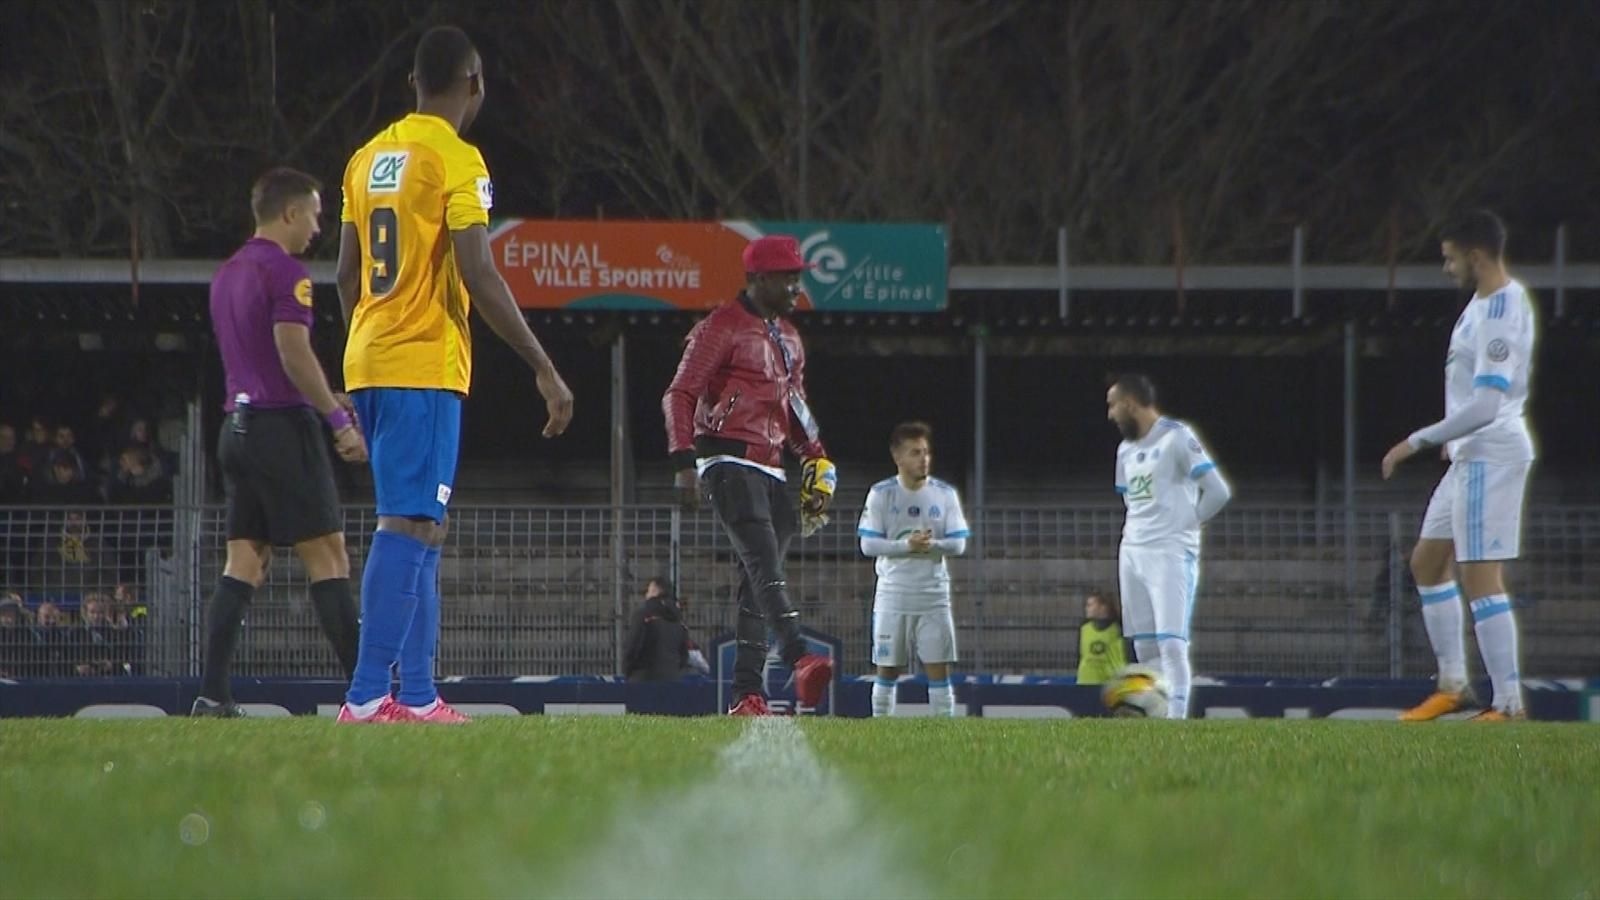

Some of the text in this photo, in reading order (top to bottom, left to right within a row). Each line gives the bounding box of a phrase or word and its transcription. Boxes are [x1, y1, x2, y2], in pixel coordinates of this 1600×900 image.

[371, 208, 398, 297] 9
[503, 237, 608, 268] ÉPINAL
[532, 268, 700, 288] VILLE SPORTIVE
[853, 264, 904, 281] ville
